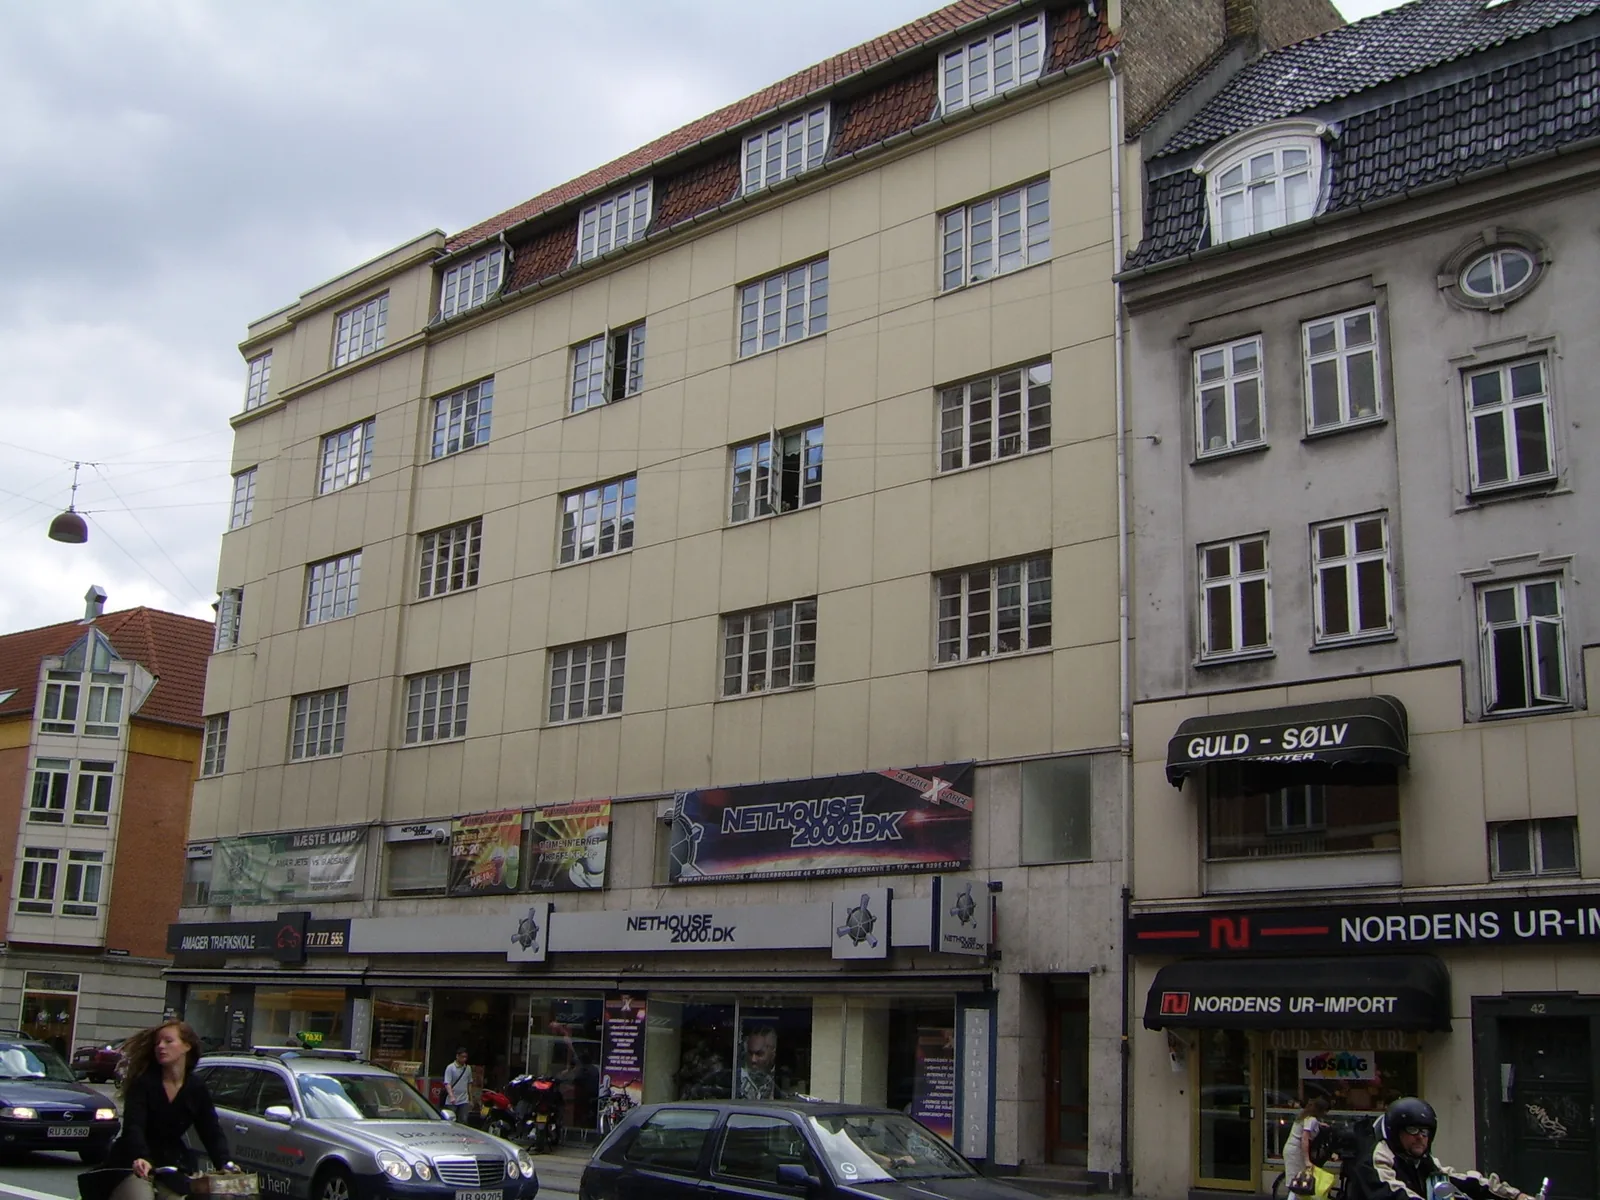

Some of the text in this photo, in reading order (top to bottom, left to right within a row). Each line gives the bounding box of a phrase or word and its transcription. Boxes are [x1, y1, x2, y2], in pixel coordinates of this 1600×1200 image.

[1187, 733, 1249, 759] GULD
[1281, 722, 1349, 750] SØLV
[721, 795, 865, 834] NETHOUSE
[293, 833, 326, 847] NÆSTE
[564, 837, 601, 848] INTERNET
[626, 914, 713, 931] NETHOUSE
[1340, 911, 1500, 943] NORDENS
[181, 935, 255, 950] AMAGER TRAFIKSKOLE
[316, 932, 329, 945] 777
[330, 932, 343, 945] 555
[670, 926, 737, 943] 2000.DK
[1194, 996, 1281, 1012] NORDENS
[1288, 996, 1398, 1013] UR-IMPORT
[1530, 1003, 1547, 1014] 42
[305, 1033, 323, 1041] TAXI
[1270, 1029, 1309, 1049] GULD
[1321, 1029, 1355, 1049] SØLV
[1305, 1057, 1368, 1072] UDSALG
[49, 1128, 60, 1136] RU
[62, 1128, 71, 1136] 30
[267, 1173, 291, 1195] hen?
